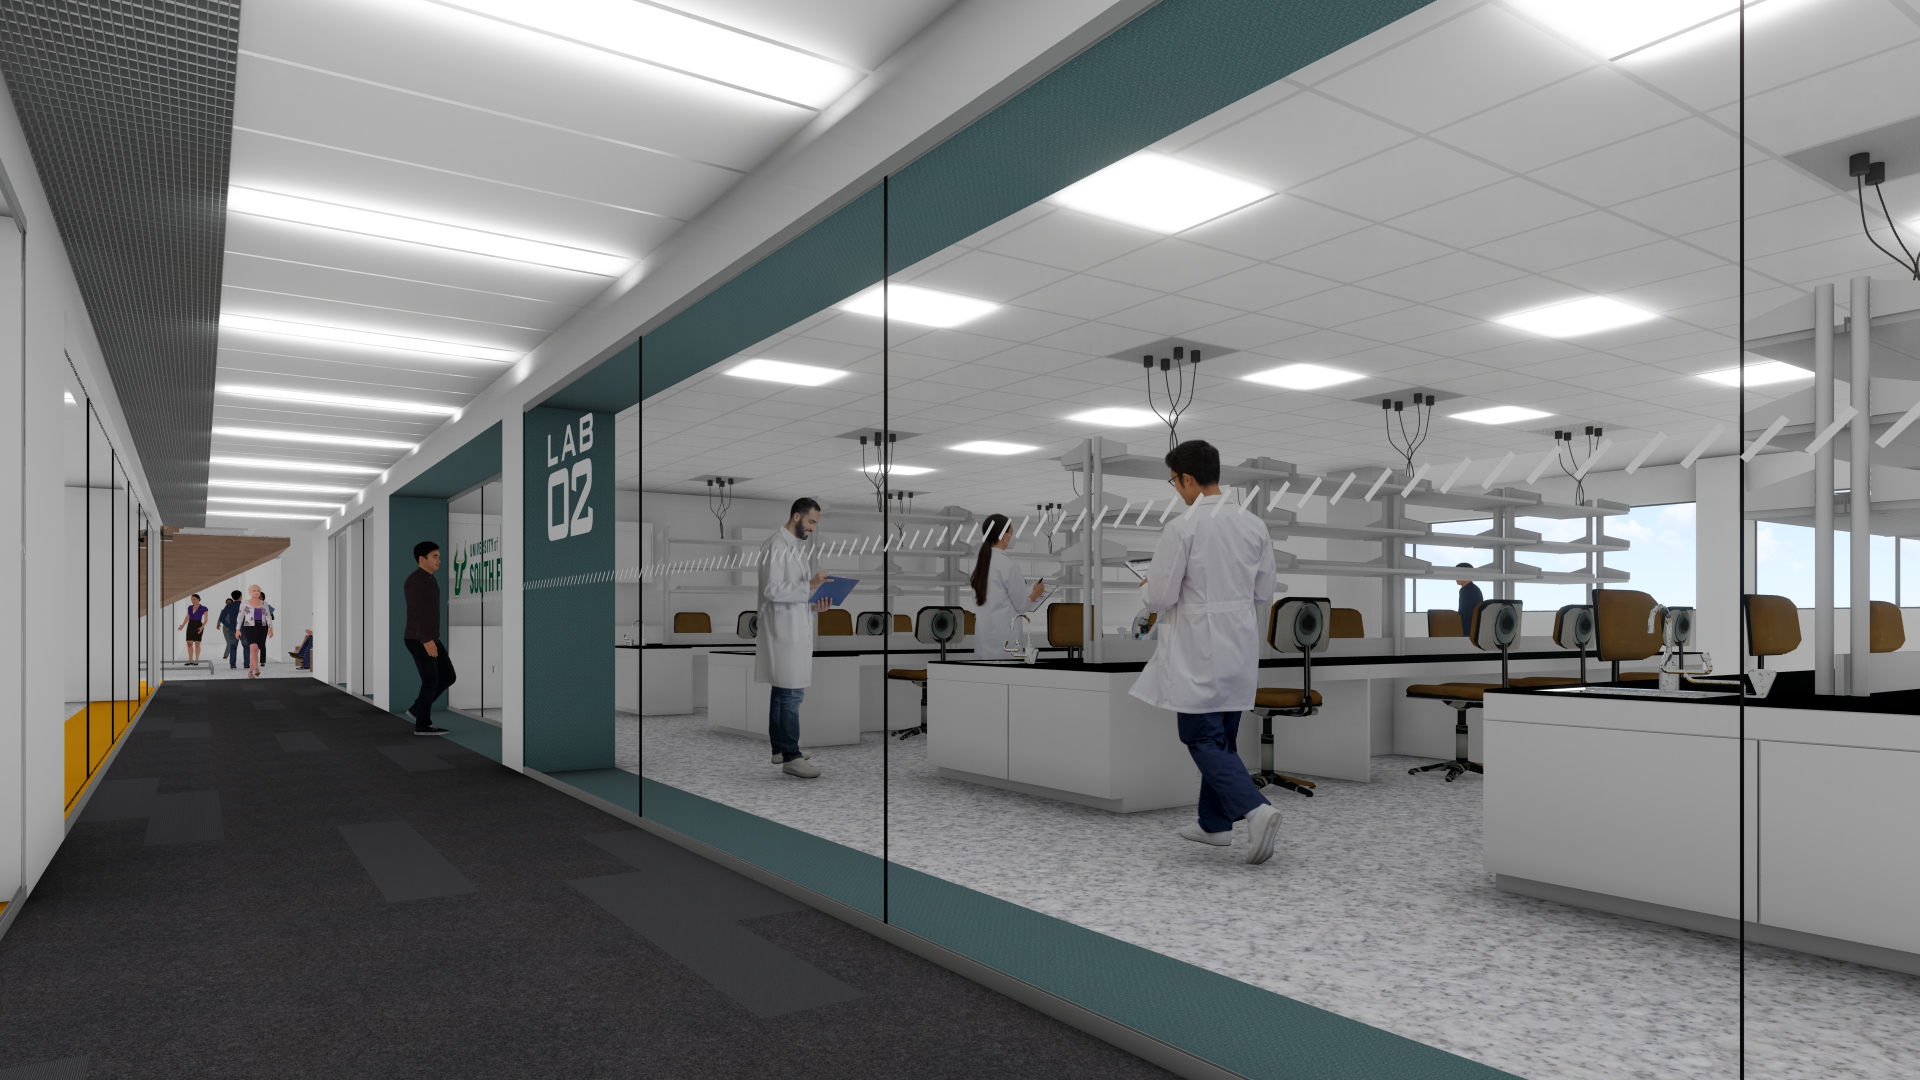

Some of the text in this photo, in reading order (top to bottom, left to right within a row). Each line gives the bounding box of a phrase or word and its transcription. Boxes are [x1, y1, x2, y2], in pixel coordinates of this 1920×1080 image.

[548, 412, 594, 468] LAB
[548, 457, 594, 541] 02
[470, 559, 494, 594] SOUTH
